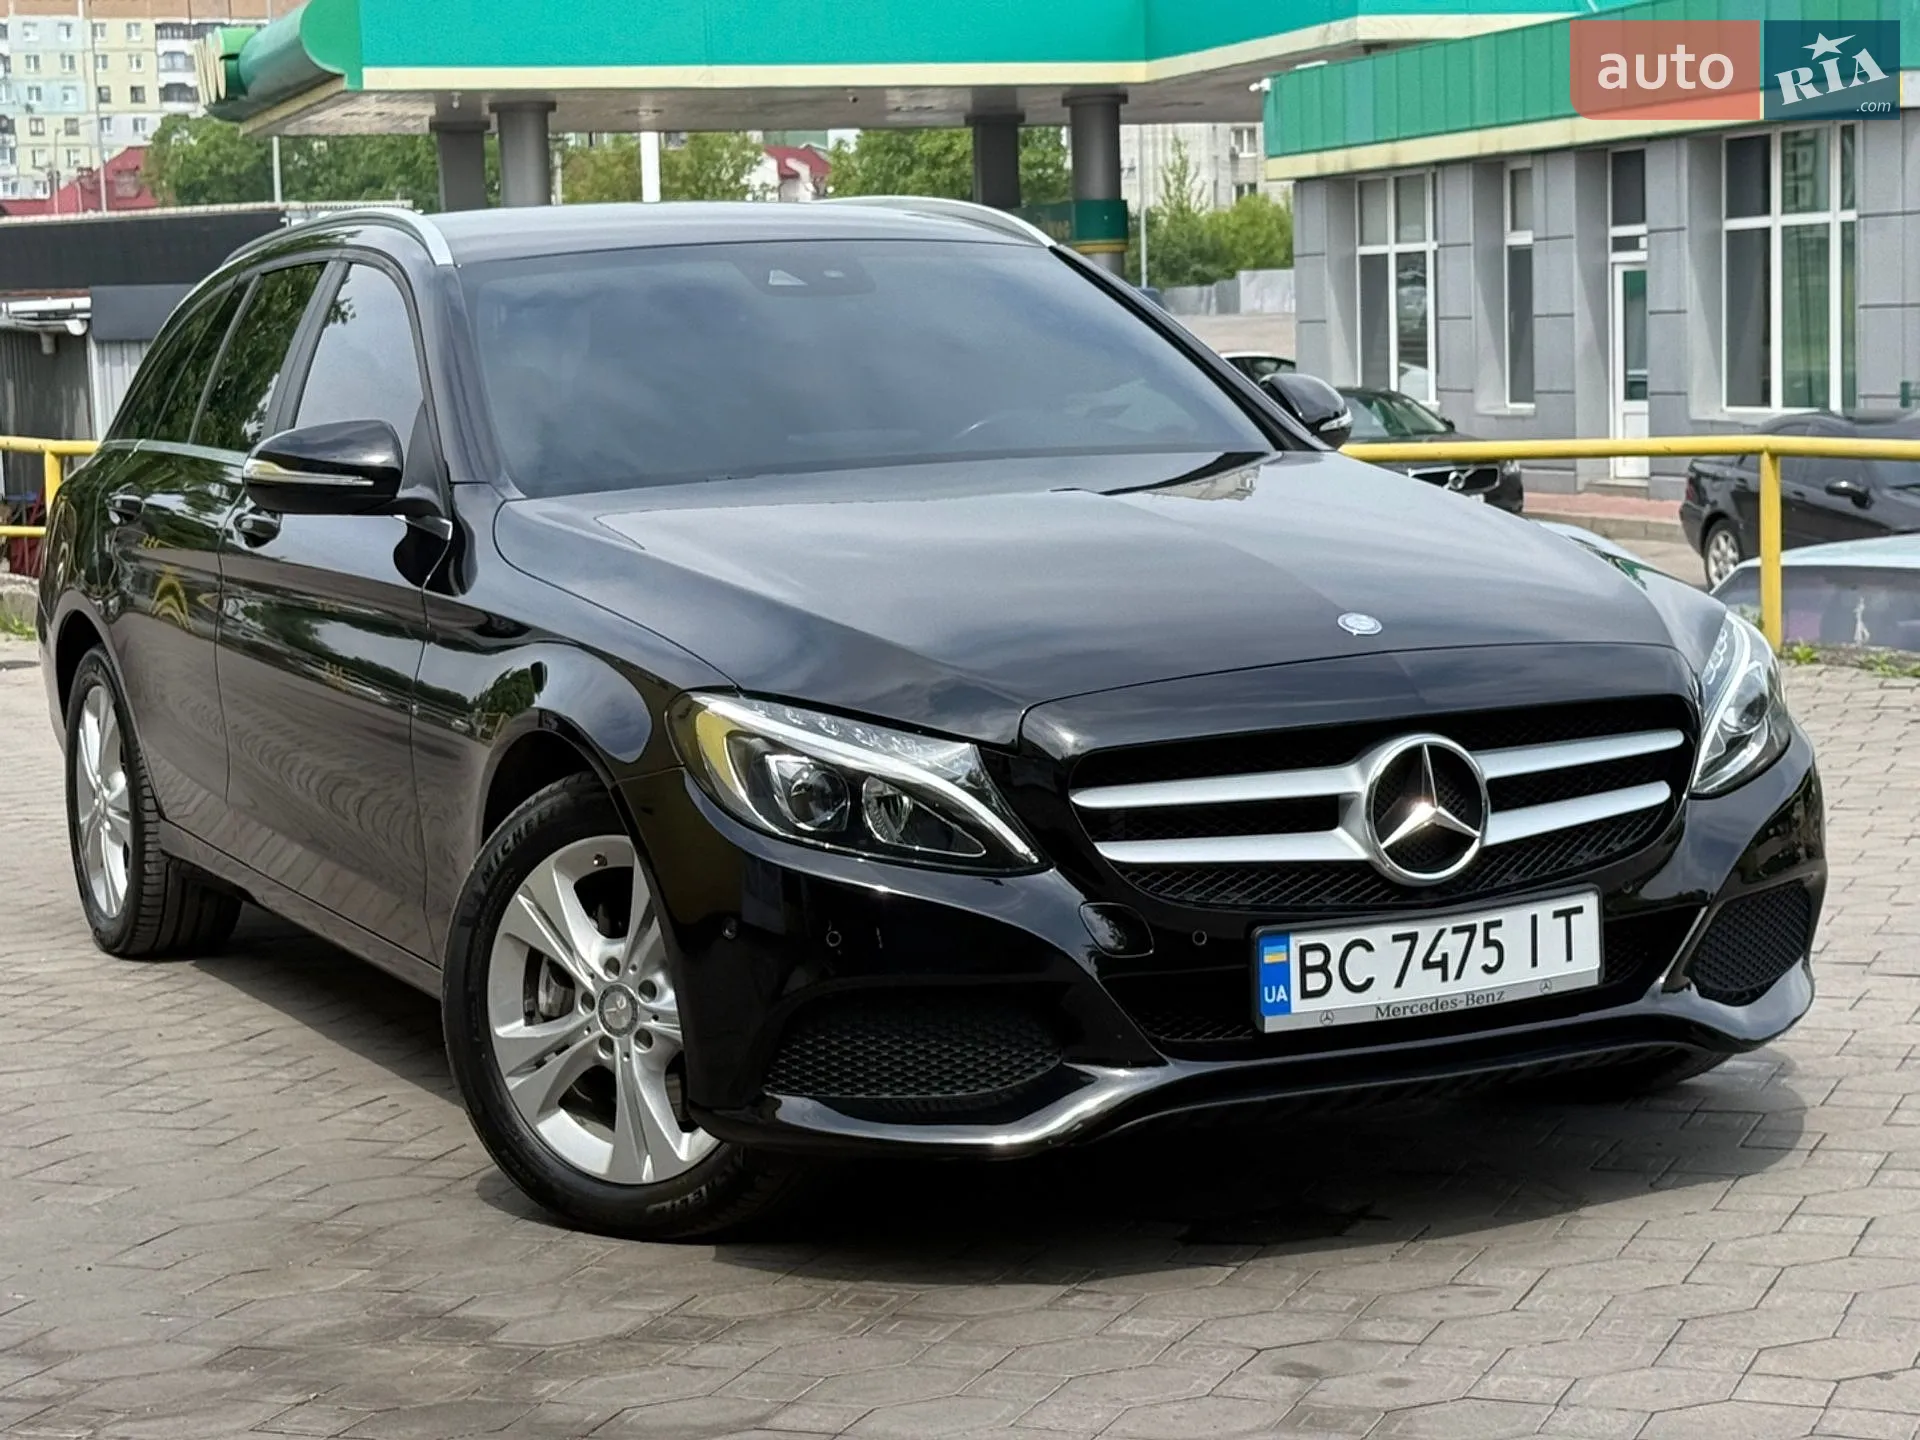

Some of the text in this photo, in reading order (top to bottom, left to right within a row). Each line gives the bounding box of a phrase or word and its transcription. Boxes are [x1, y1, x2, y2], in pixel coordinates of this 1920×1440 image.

[481, 804, 558, 885] MICHEL
[1299, 905, 1585, 1001] BC 7475 IT
[1263, 986, 1288, 1004] UA
[1374, 990, 1506, 1020] Mercedes-Benz
